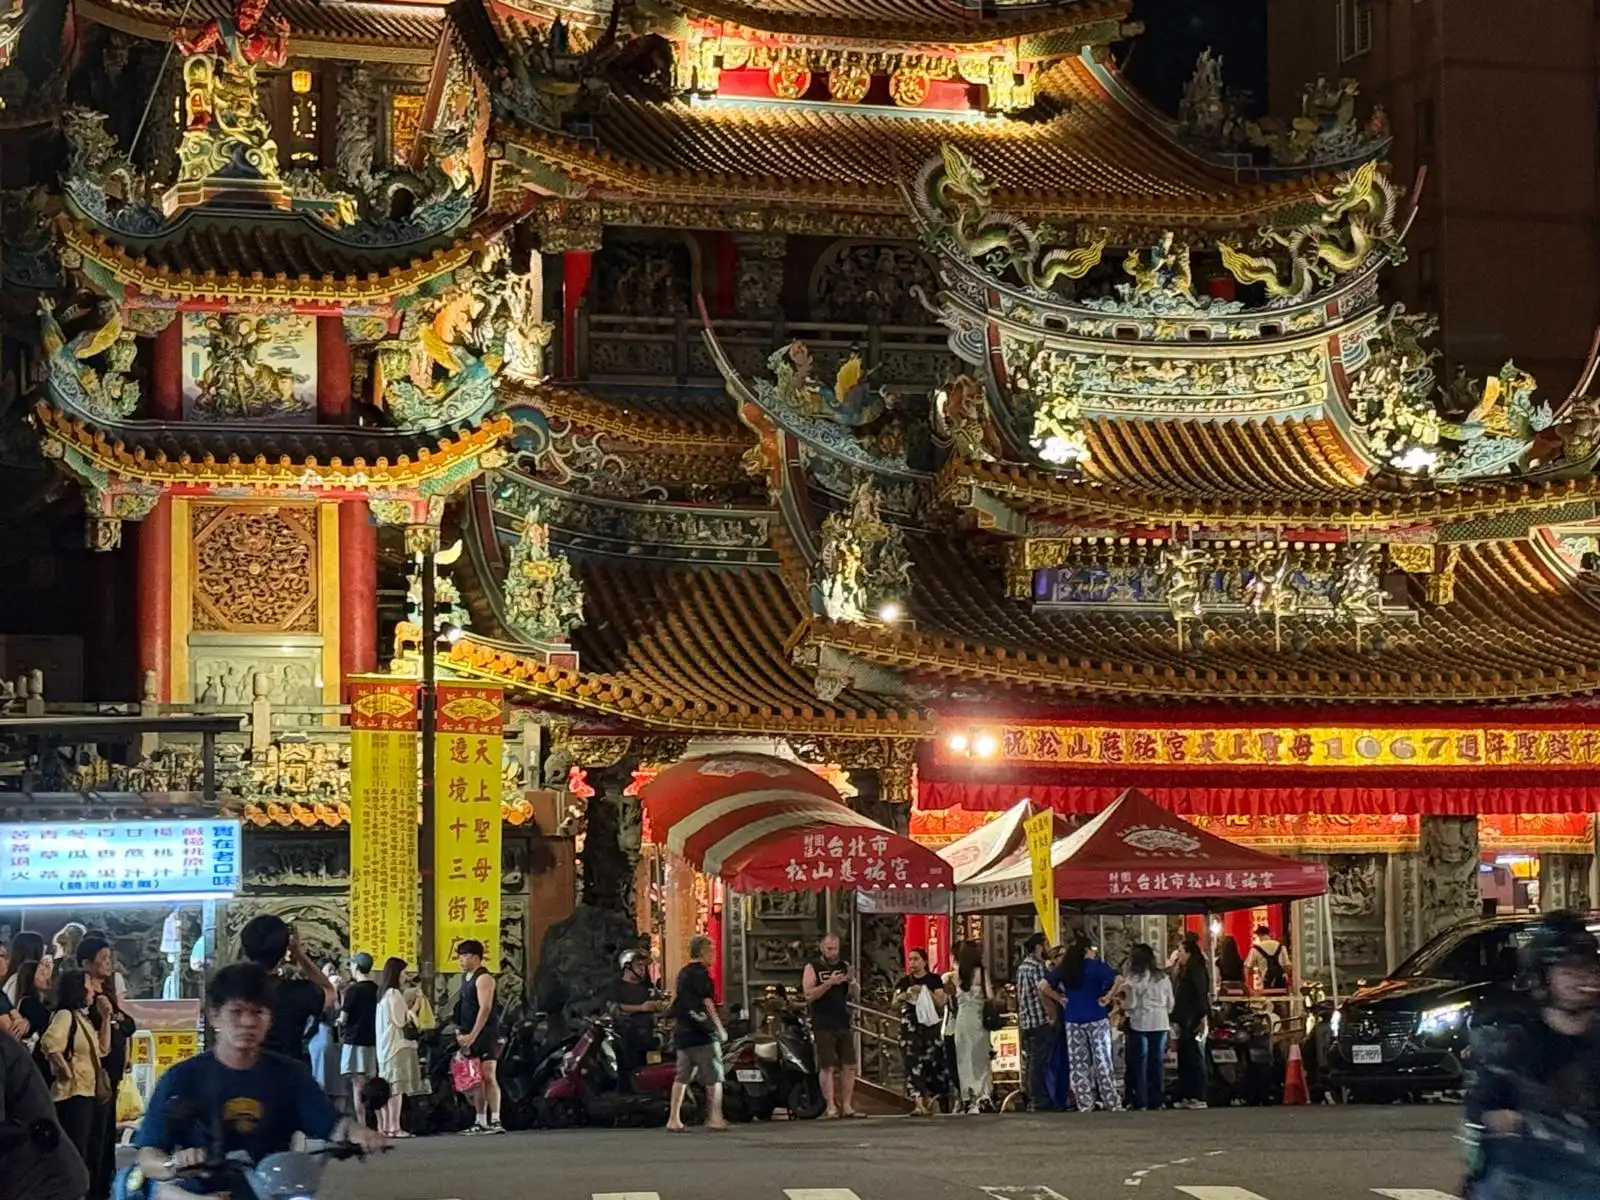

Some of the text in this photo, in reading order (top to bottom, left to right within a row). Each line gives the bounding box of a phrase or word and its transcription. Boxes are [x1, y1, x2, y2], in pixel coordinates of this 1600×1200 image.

[827, 835, 890, 857] 台北市
[785, 857, 910, 882] 松山慈祐宮
